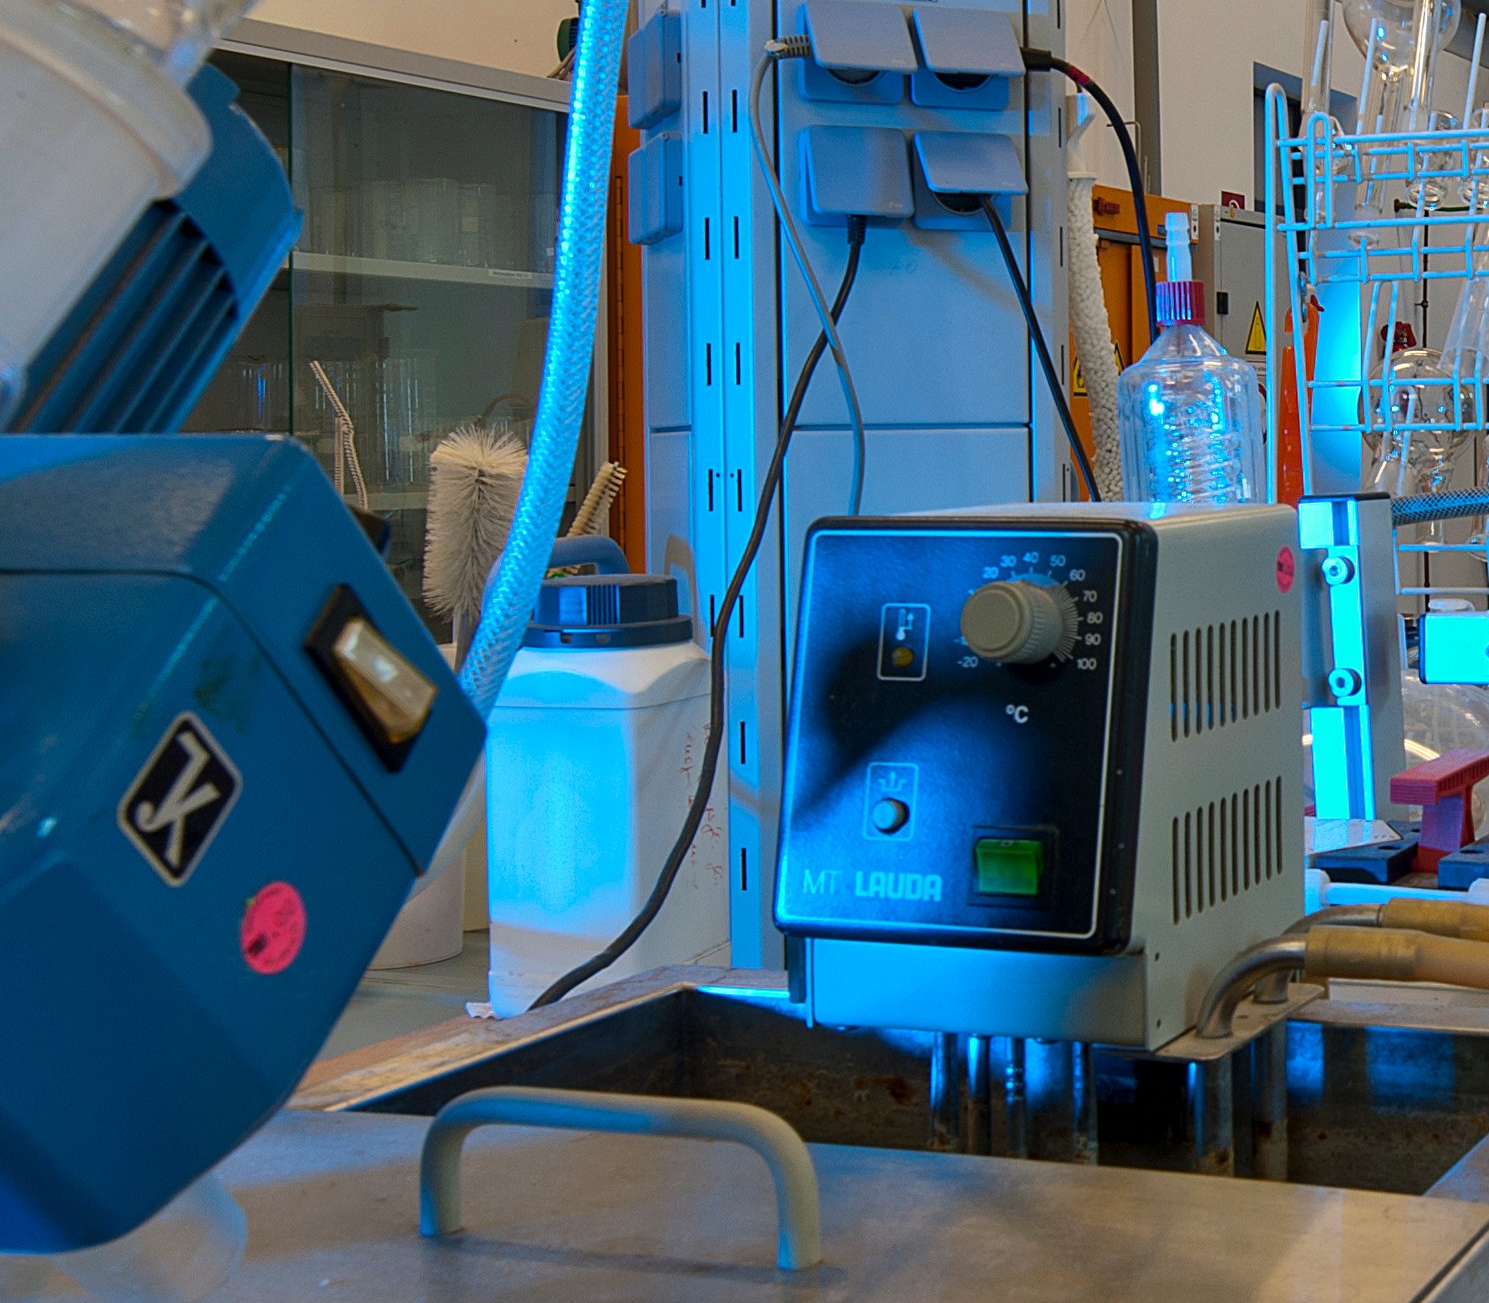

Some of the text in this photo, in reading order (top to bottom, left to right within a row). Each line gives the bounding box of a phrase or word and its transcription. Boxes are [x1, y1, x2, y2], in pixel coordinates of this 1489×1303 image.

[1000, 555, 1017, 568] 30
[1023, 551, 1039, 564] 40
[1050, 555, 1066, 568] 50
[982, 566, 999, 579] 20
[1069, 569, 1086, 581] 60
[1083, 590, 1097, 602] 70
[1087, 612, 1103, 624] 80
[1085, 633, 1101, 645] 90
[957, 656, 978, 668] -20
[1077, 658, 1097, 670] 100
[1005, 704, 1029, 724] °C
[802, 869, 942, 902] MT LAUDA
